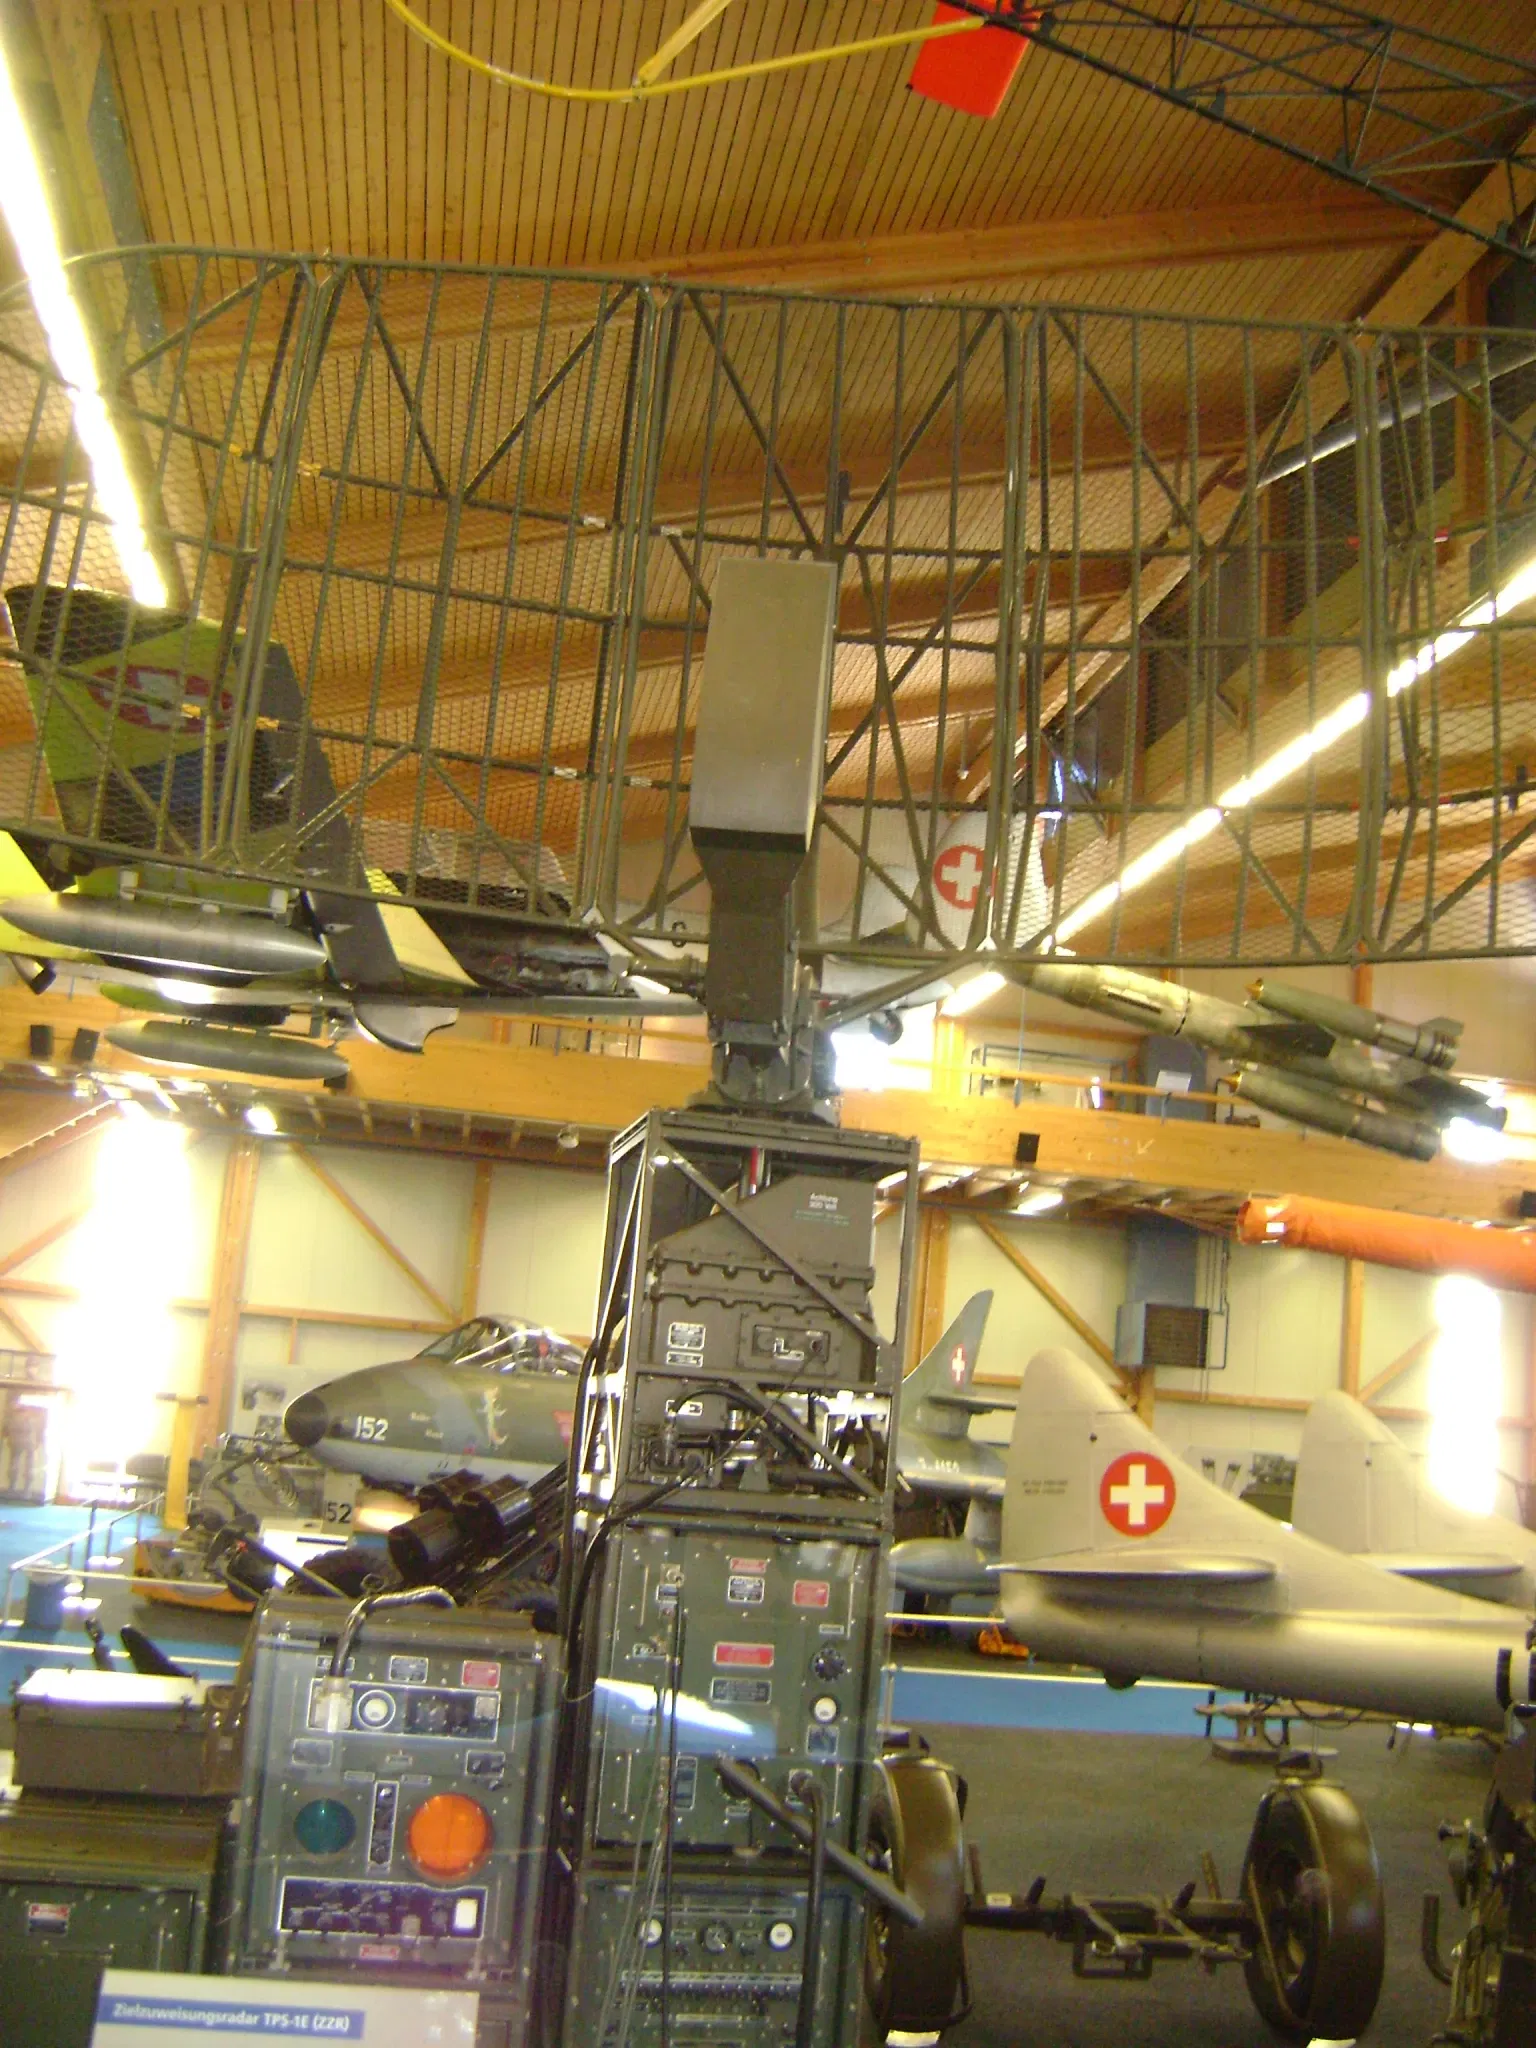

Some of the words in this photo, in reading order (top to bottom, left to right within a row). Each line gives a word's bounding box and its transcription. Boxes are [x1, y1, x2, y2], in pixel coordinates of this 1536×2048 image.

[354, 1415, 389, 1441] 152
[113, 2003, 259, 2027] Zielzuweisungsradar
[263, 2012, 309, 2029] TPS-1E
[312, 2014, 350, 2033] (ZZR)
